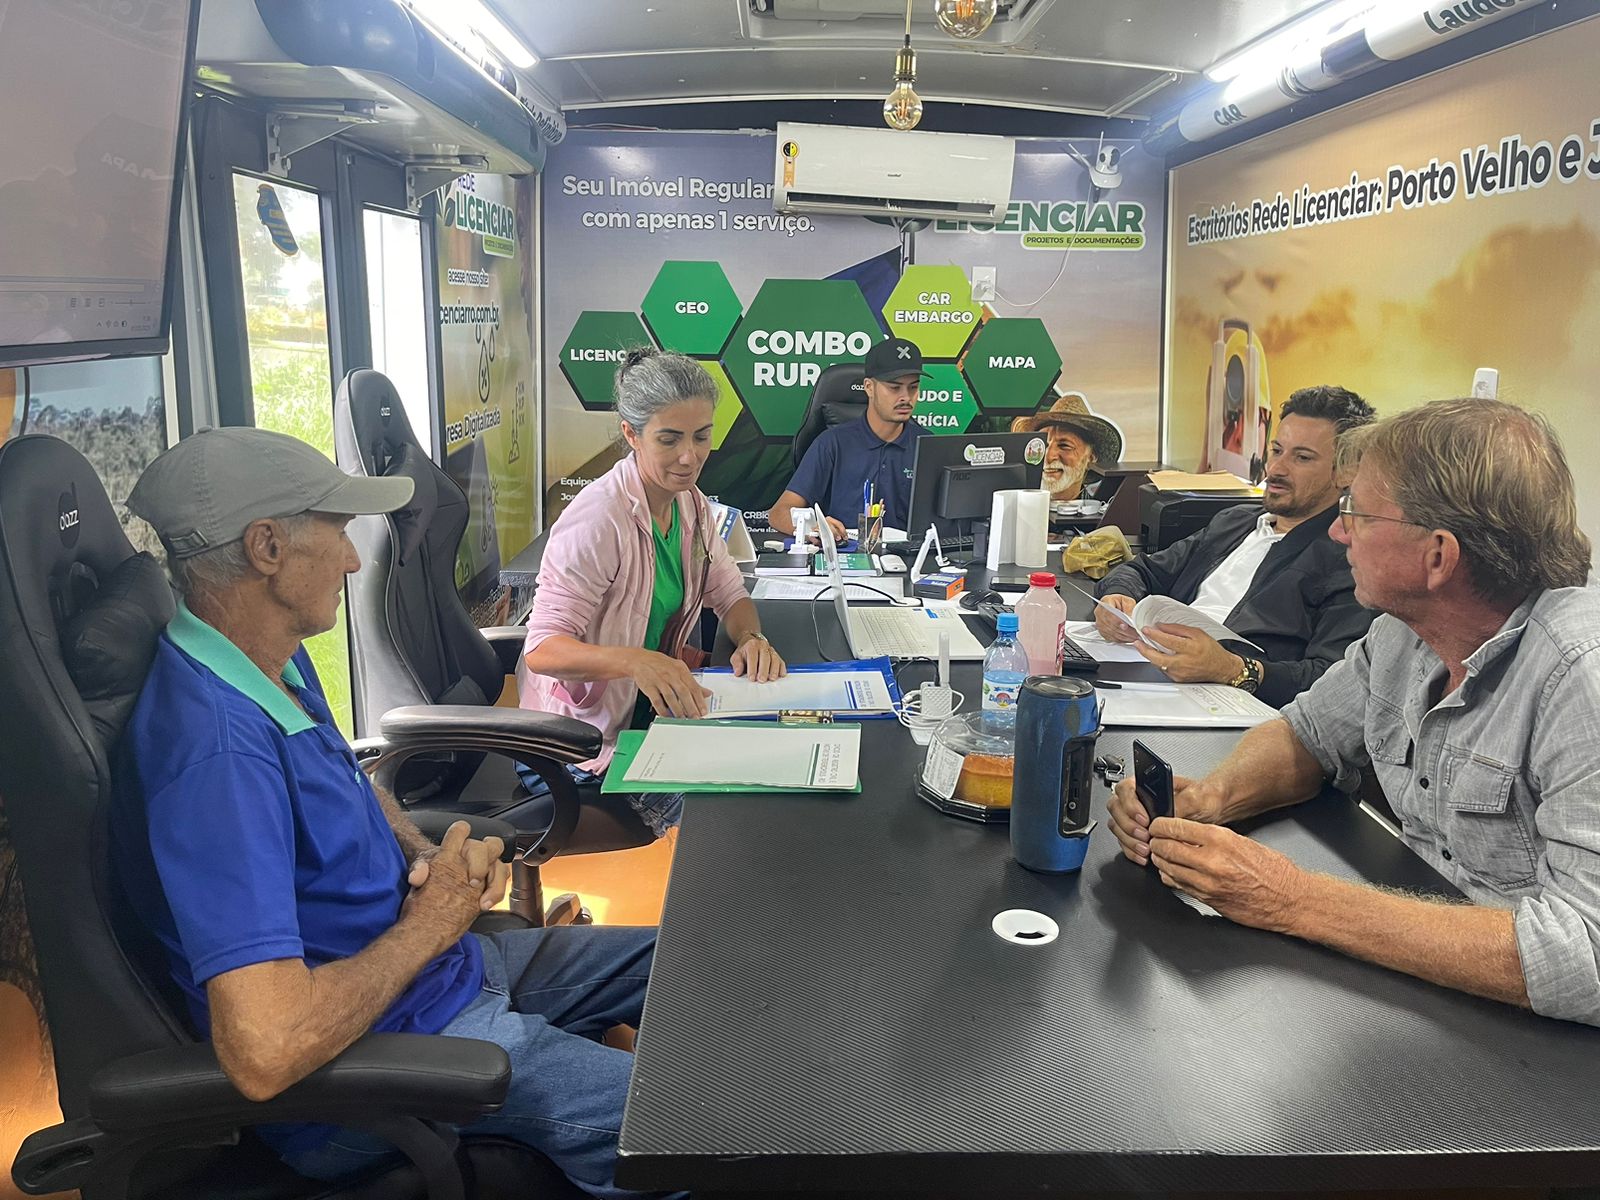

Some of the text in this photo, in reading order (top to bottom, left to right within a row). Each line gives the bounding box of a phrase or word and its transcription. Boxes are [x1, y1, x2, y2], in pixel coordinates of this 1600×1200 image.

[1214, 103, 1247, 126] CAR
[562, 175, 776, 202] Seu Imóvel Regular
[1188, 206, 1249, 243] Escritórios
[1252, 196, 1290, 233] Rede
[1293, 176, 1382, 225] Licenciar:
[1387, 163, 1456, 205] Porto
[1463, 140, 1551, 194] Velho
[1559, 140, 1581, 178] e
[456, 190, 514, 240] LICENCIAR
[582, 211, 815, 236] com apenas 1 serviço.
[936, 203, 1143, 233] ENCIAR
[1026, 237, 1064, 245] PROJETOS
[1075, 236, 1140, 246] DOCUMENTAÇÕES
[674, 301, 709, 314] GEO
[918, 292, 951, 305] CAR
[894, 311, 973, 323] EMBARGO
[747, 330, 872, 356] COMBO
[988, 356, 1036, 369] MAPA
[753, 362, 832, 387] RUR
[952, 390, 963, 402] E
[464, 408, 500, 439] Digitalizada
[952, 472, 971, 481] AOC
[60, 509, 79, 530] dazz
